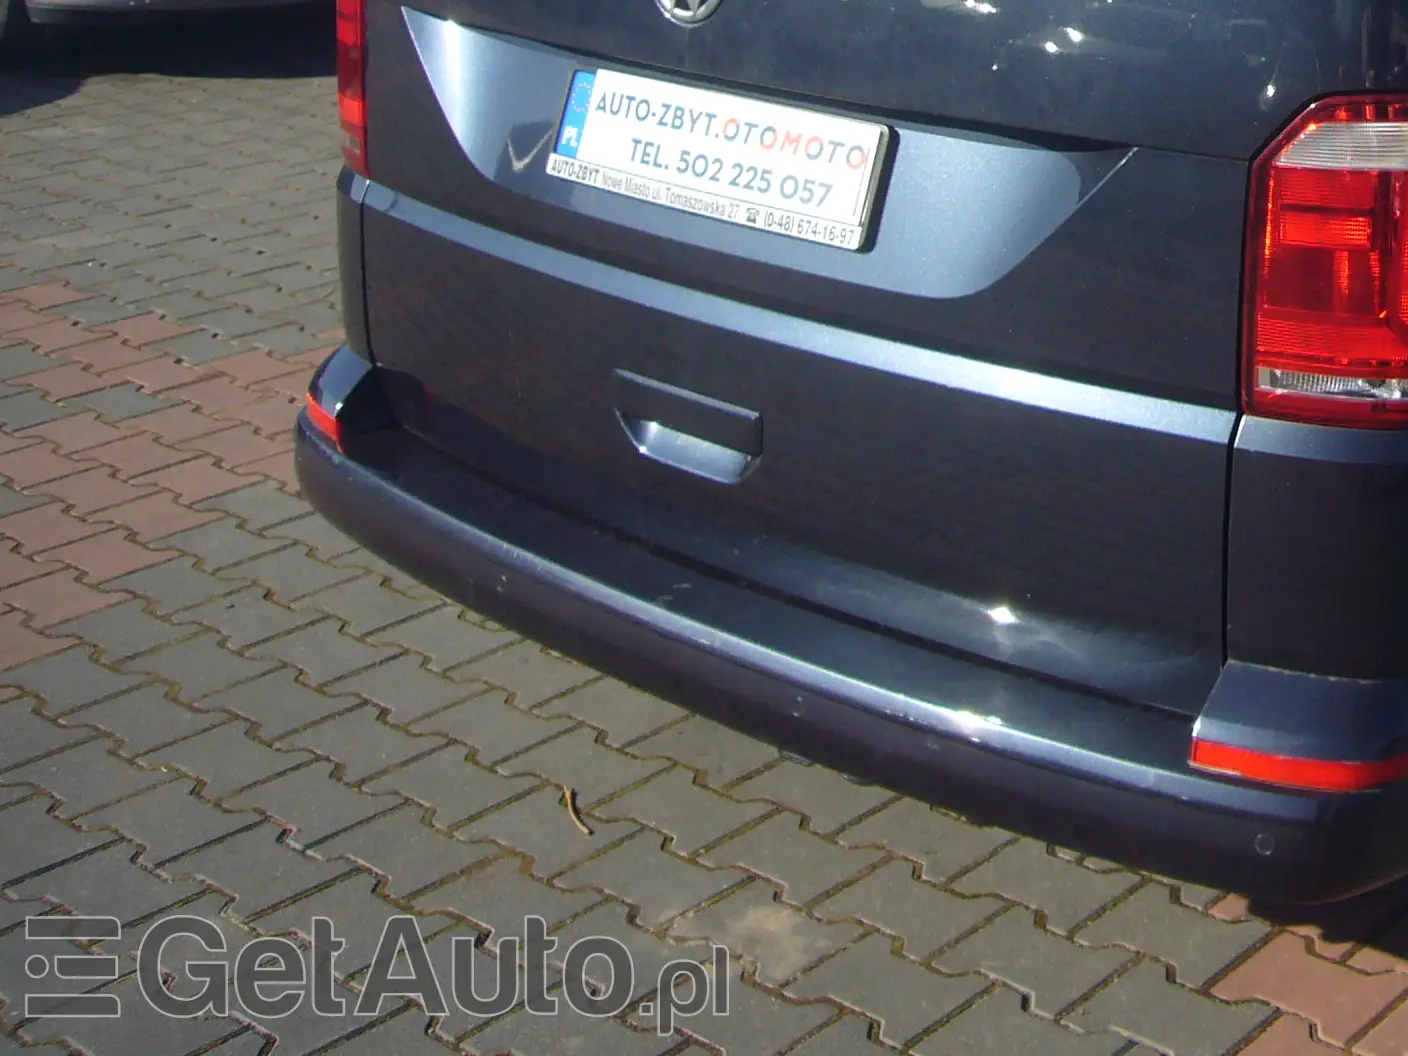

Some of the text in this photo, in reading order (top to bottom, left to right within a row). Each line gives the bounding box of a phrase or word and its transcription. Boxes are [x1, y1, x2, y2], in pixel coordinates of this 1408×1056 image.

[561, 125, 579, 148] PL
[595, 91, 866, 170] AUTO-ZBYT.OTOMOTO
[551, 157, 600, 185] AUTO-ZBYT
[601, 172, 623, 191] Nowe
[625, 175, 651, 199] Miasto
[651, 185, 665, 203] ul.
[665, 186, 726, 217] Tomaszowska
[728, 202, 740, 220] 27
[797, 218, 855, 246] 674-16-97
[630, 137, 834, 208] TEL. 502 225 057
